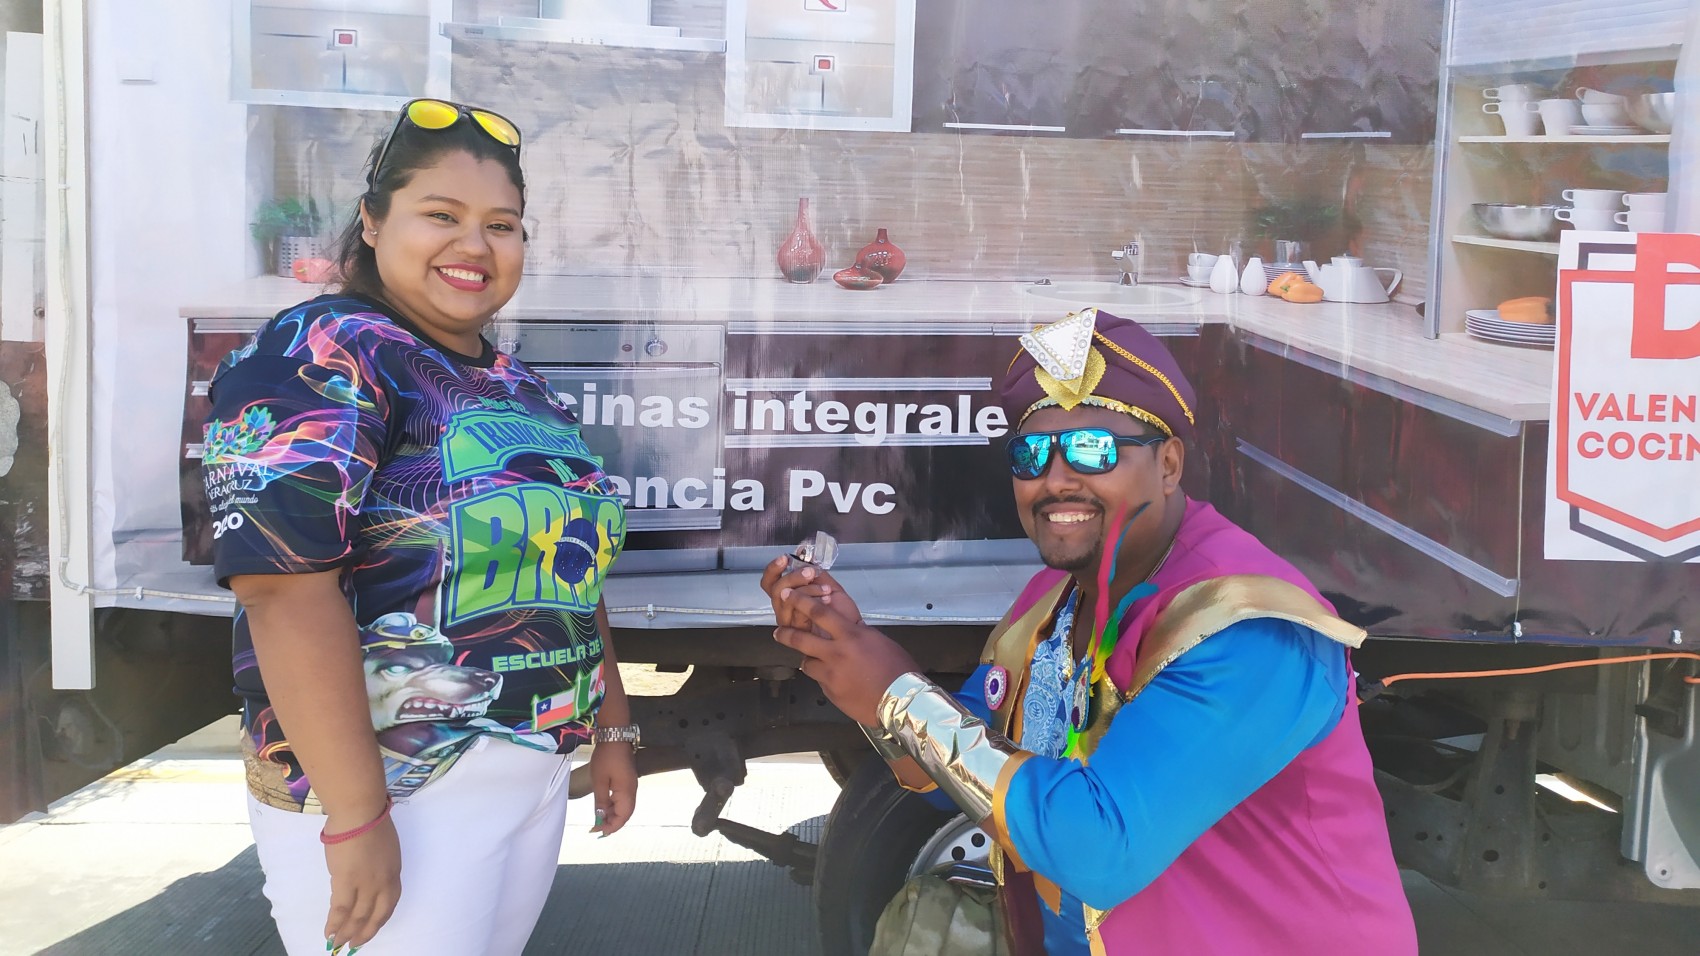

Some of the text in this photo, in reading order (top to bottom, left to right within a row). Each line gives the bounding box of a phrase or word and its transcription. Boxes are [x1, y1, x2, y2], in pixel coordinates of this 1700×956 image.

[1574, 392, 1697, 423] VALEN
[203, 461, 274, 490] ARNAVAL
[788, 469, 897, 515] Pvc
[492, 644, 586, 672] ESCUELA
